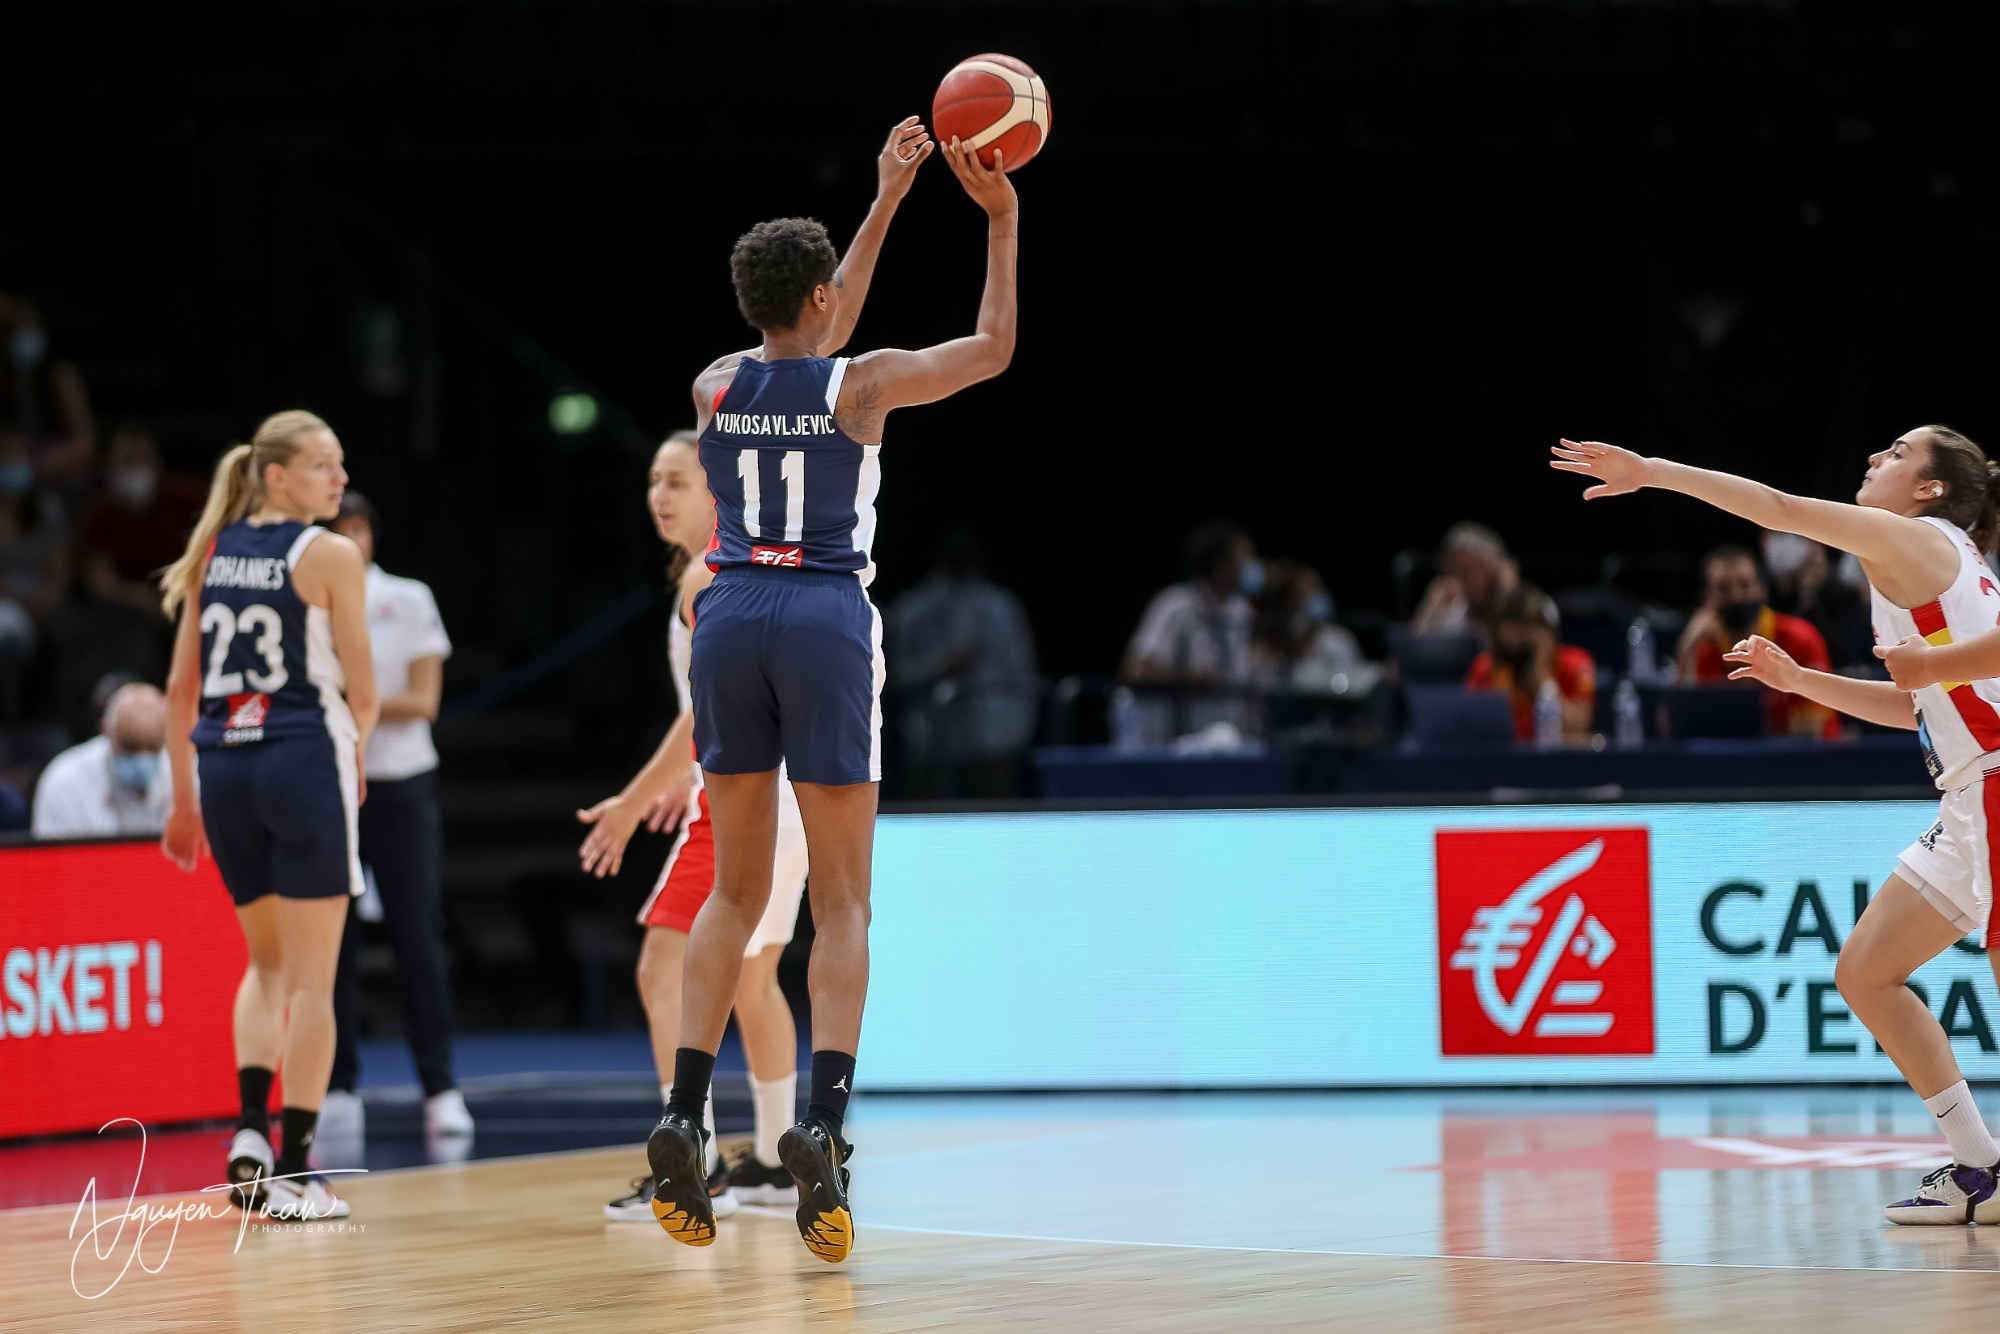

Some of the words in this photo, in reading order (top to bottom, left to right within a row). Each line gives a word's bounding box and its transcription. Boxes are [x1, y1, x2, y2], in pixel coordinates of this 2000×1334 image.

[715, 411, 836, 436] VUKOSAVLJEVIC
[737, 449, 805, 542] 11
[205, 555, 286, 591] JOHANNES
[200, 601, 290, 698] 23
[0, 938, 164, 1040] SKET!
[1707, 979, 2000, 1054] D'EA
